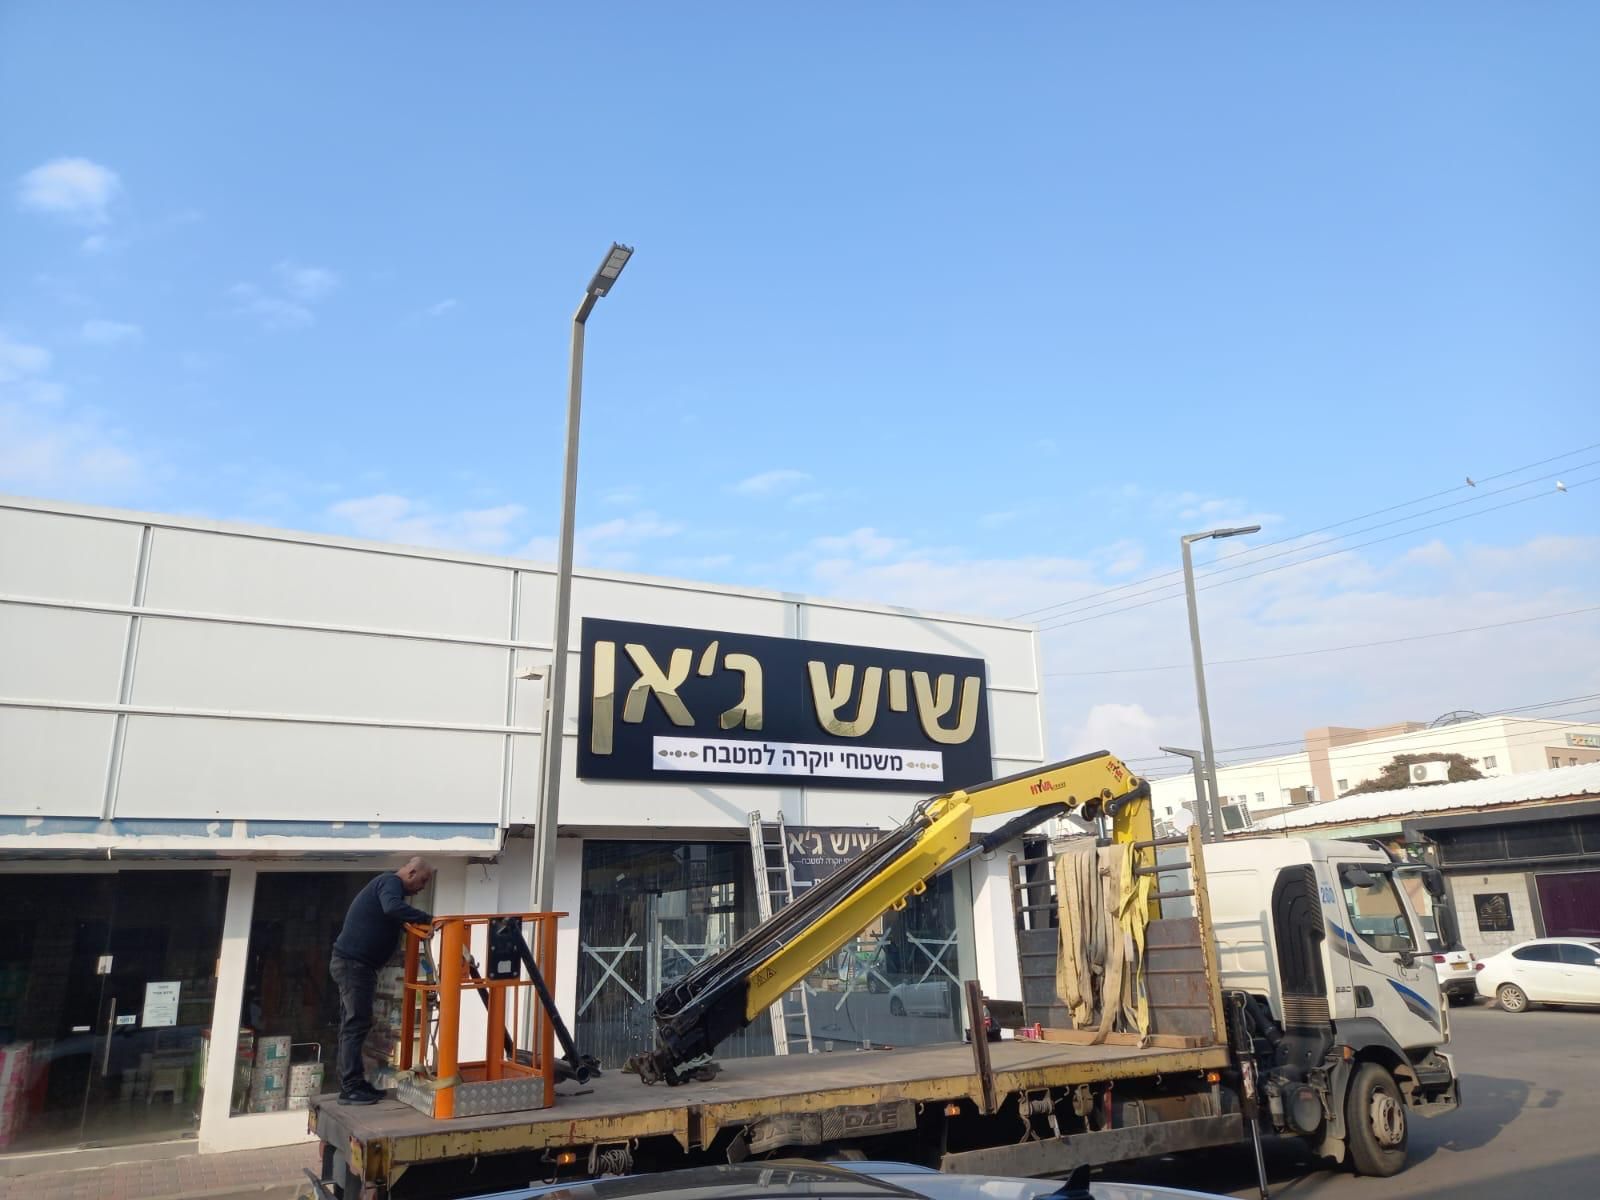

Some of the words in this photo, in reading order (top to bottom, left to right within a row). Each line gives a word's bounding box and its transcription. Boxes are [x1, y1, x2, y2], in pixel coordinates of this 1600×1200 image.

[592, 640, 764, 755] ג'אן
[808, 660, 981, 744] שיש
[702, 743, 776, 766] למטבח
[782, 749, 834, 774] יוקרה
[841, 752, 903, 771] משטחי
[787, 830, 823, 855] ג'א
[830, 833, 878, 855] שיש
